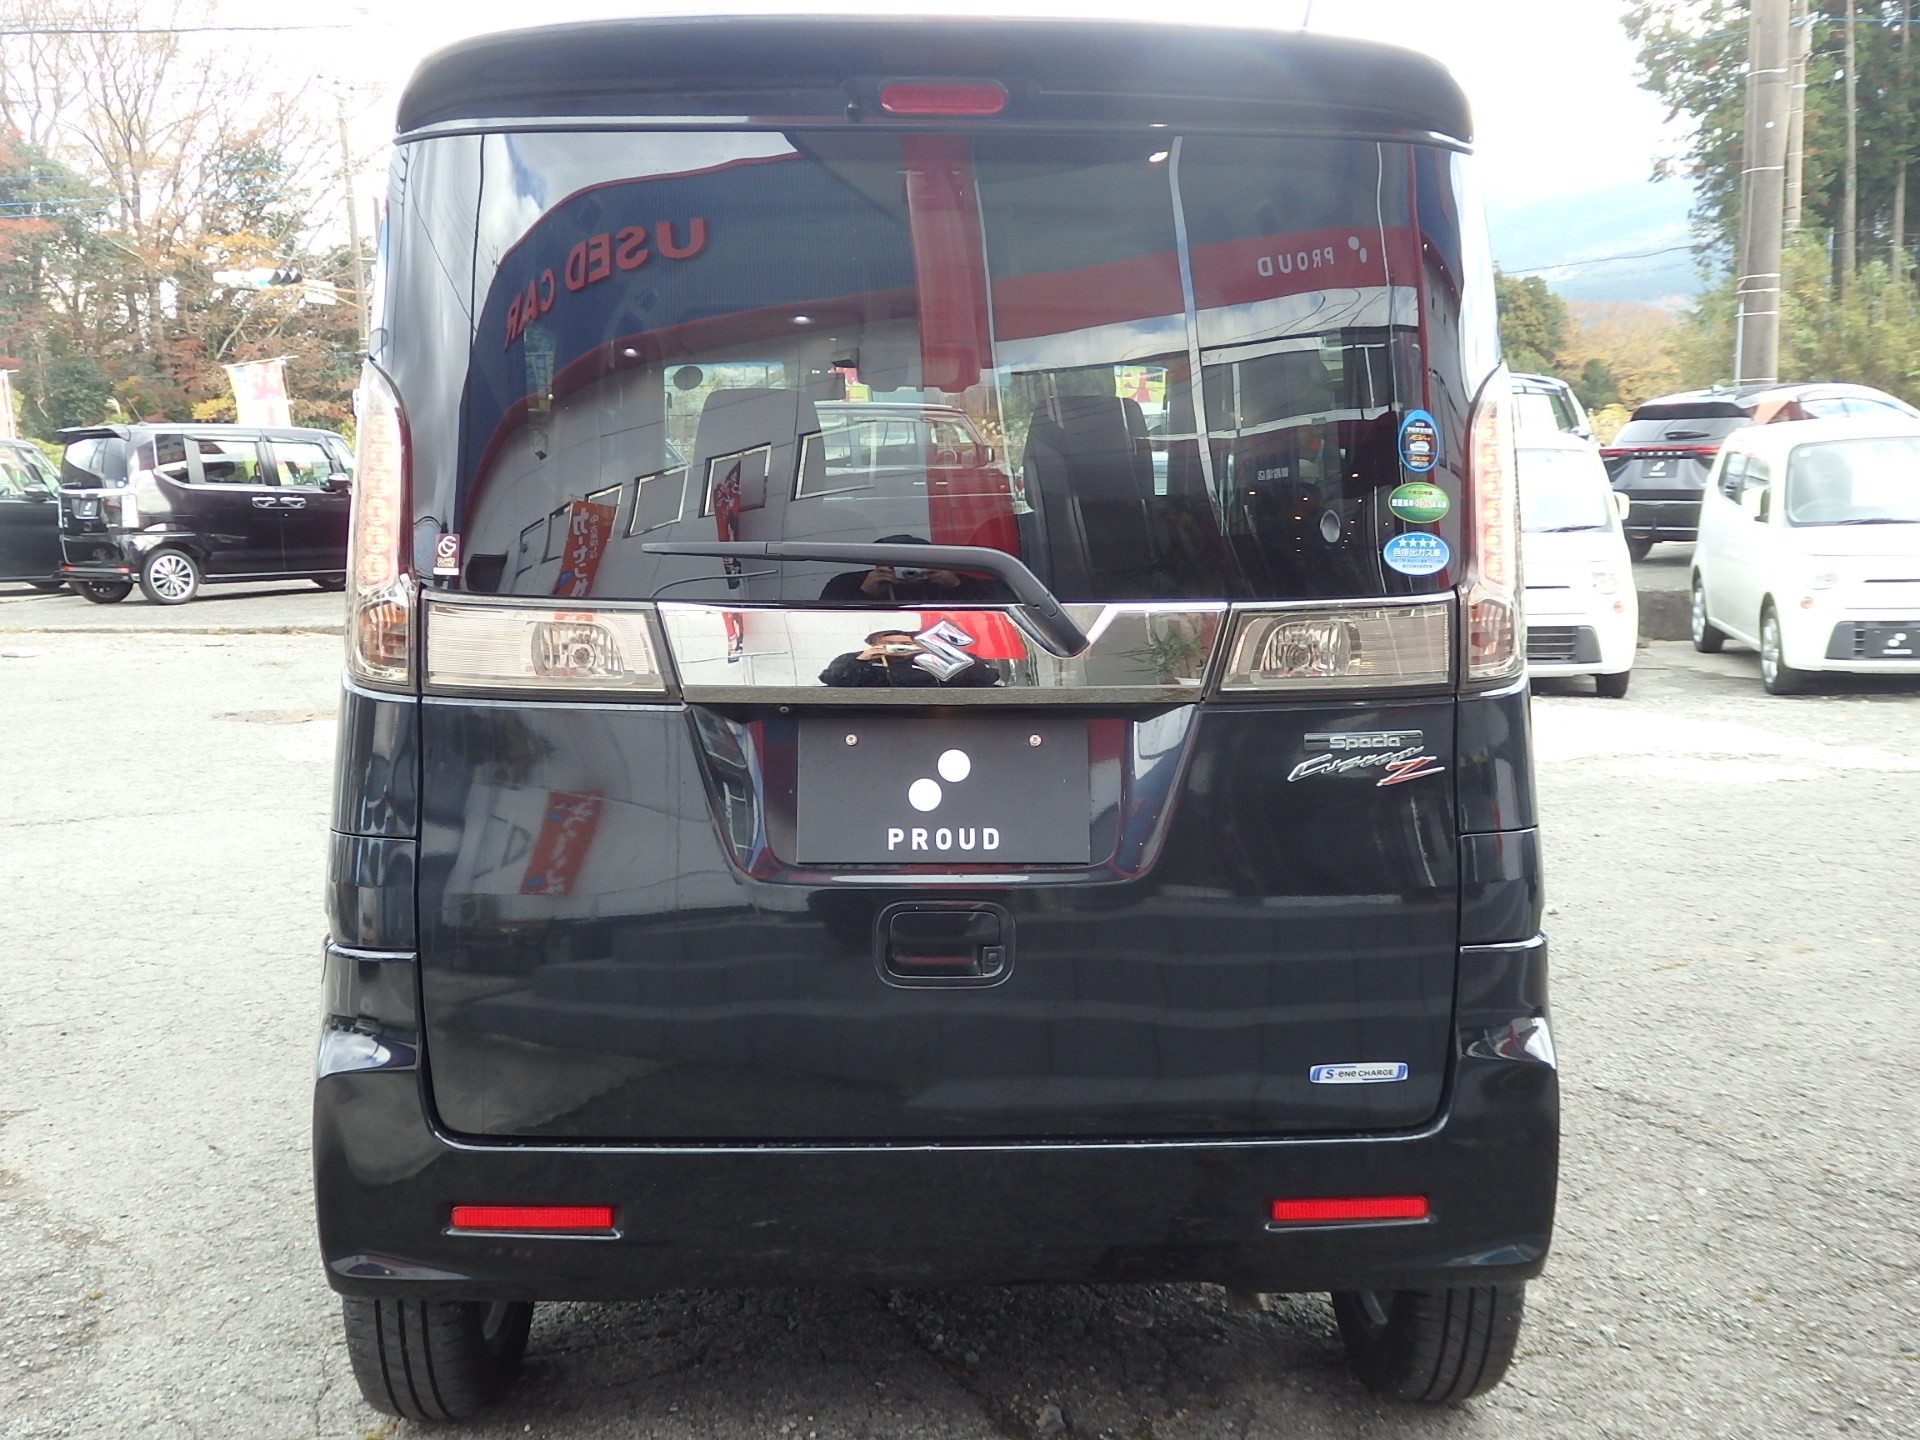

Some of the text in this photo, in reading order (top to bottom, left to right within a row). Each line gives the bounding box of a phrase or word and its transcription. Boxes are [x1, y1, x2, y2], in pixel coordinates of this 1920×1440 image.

[1329, 734, 1401, 751] Spacia
[887, 827, 1000, 850] PROUD
[1358, 1069, 1394, 1077] CHARGE
